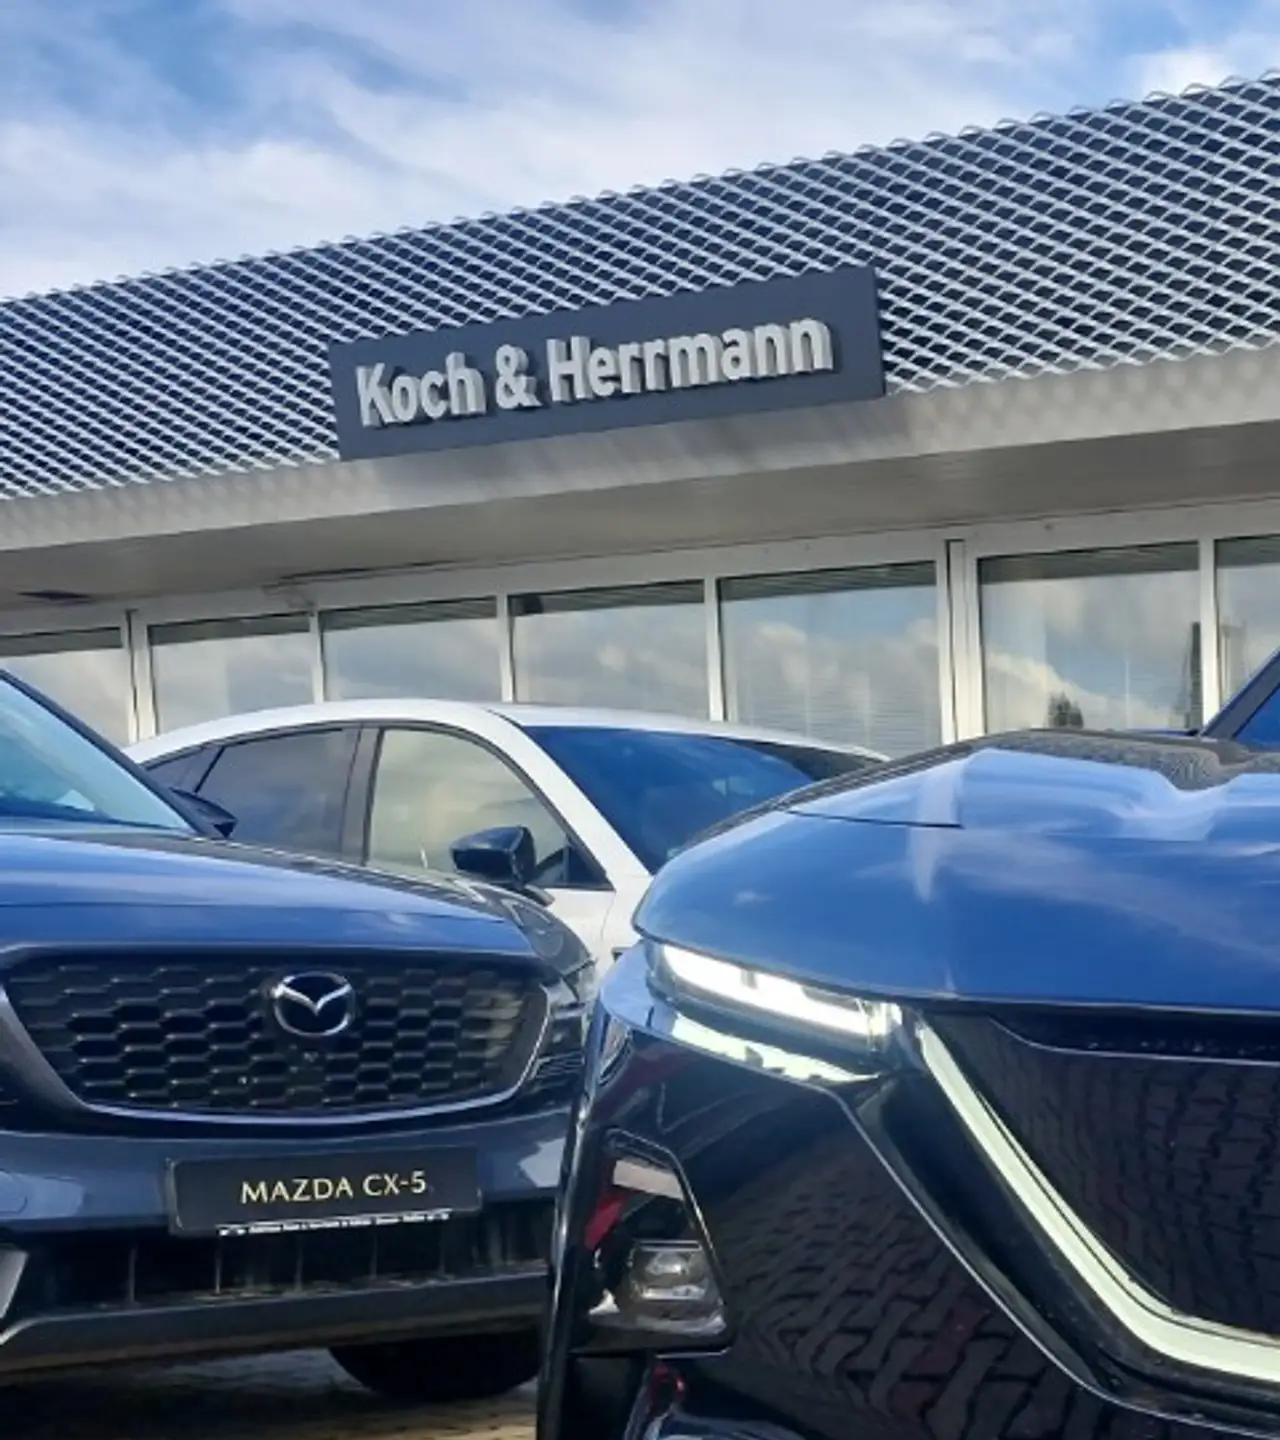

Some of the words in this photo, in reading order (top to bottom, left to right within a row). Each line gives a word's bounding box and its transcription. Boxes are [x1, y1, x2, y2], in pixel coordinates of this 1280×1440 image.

[356, 351, 487, 428] Koch
[495, 343, 542, 409] &
[546, 317, 834, 402] Herrmann
[240, 1176, 354, 1204] MAZDA
[362, 1170, 427, 1196] CX-5
